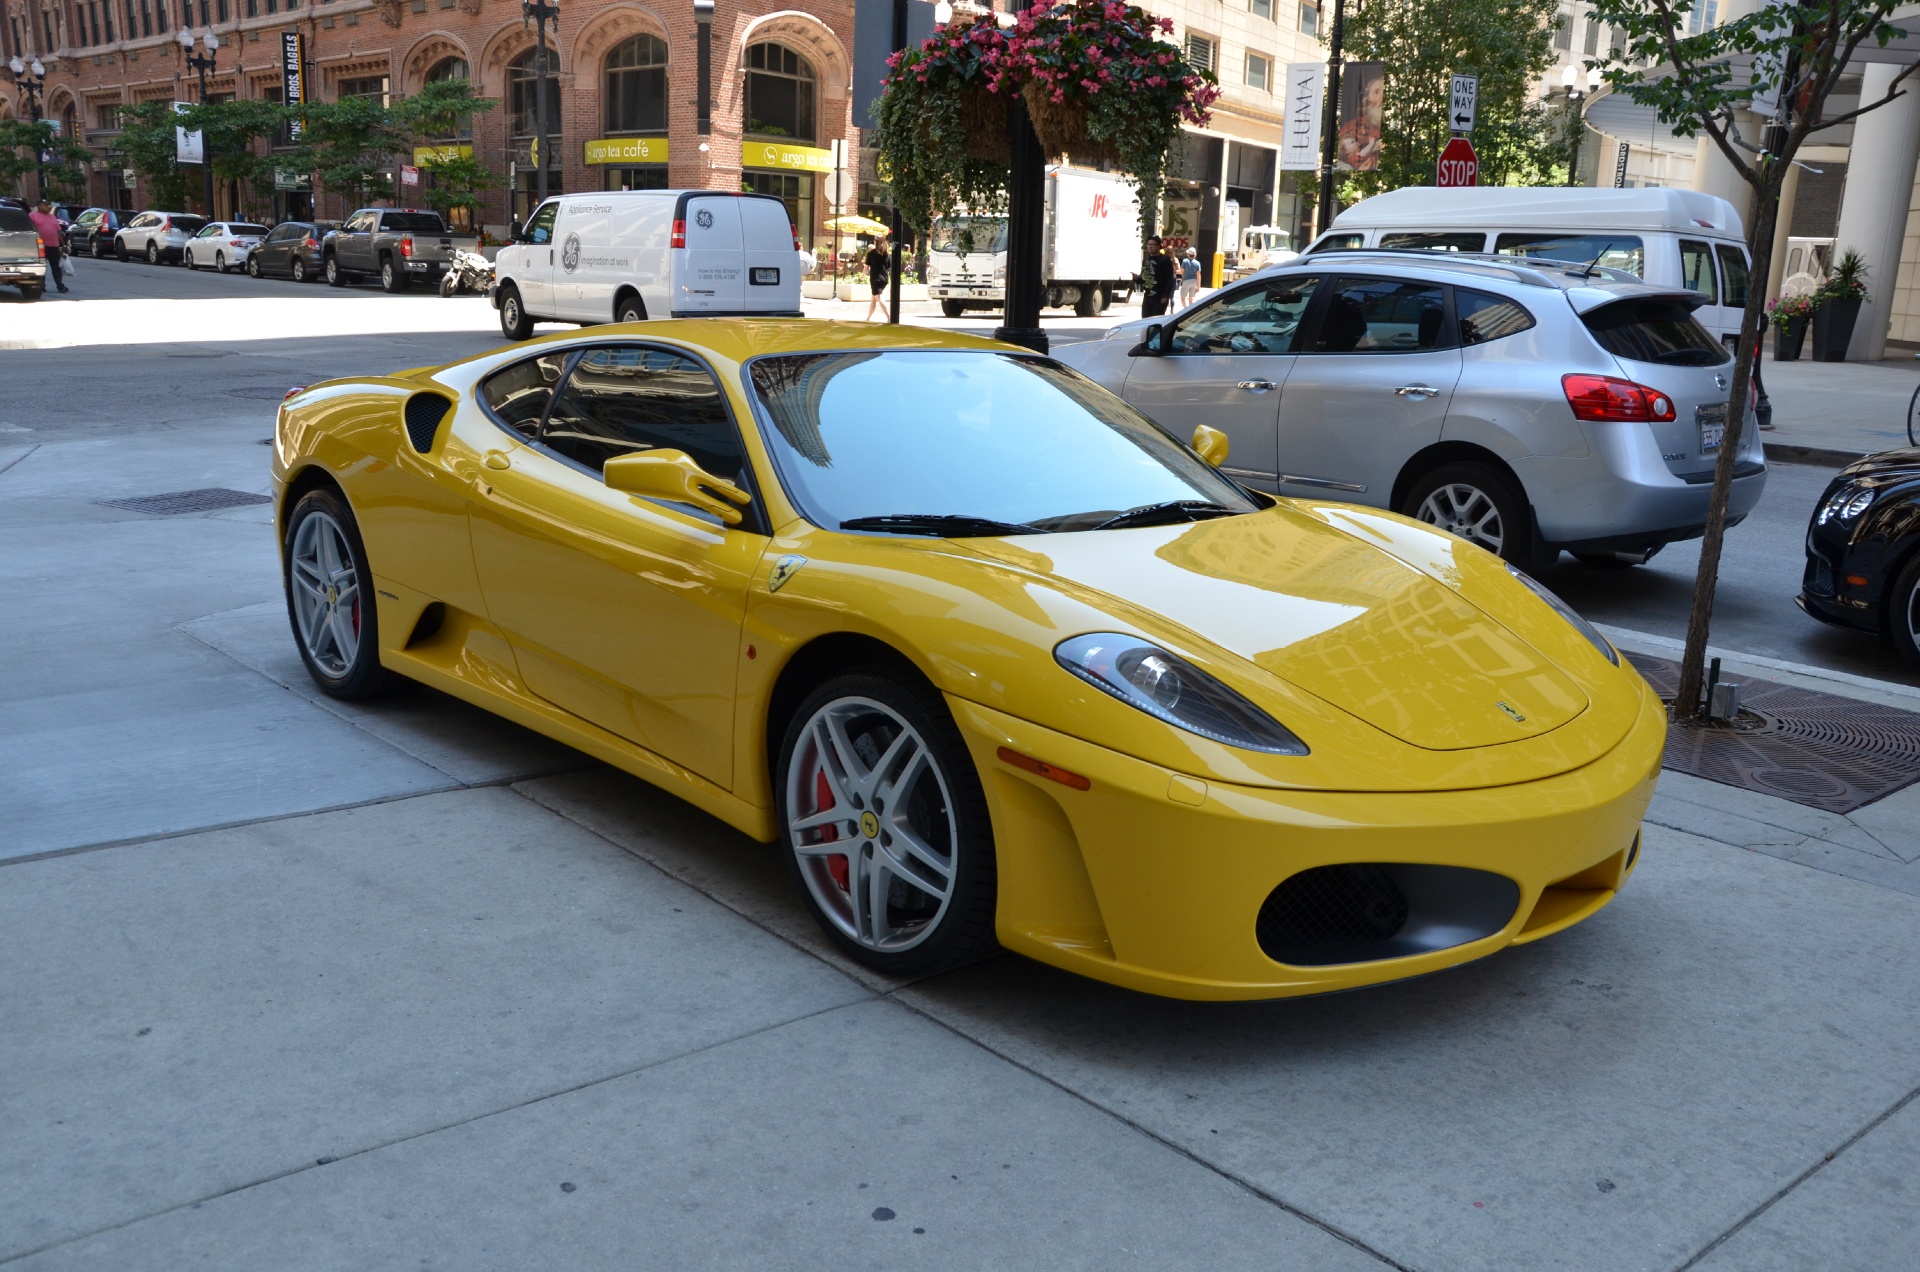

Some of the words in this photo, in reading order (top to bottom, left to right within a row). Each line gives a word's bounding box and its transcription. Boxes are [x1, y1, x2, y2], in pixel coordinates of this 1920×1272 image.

[286, 35, 298, 70] BAGELS
[288, 73, 301, 97] BROS.
[1454, 80, 1474, 95] ONE
[1454, 96, 1474, 110] WAY
[1293, 76, 1314, 149] LUMA
[608, 145, 620, 158] tea
[623, 139, 649, 157] café
[781, 152, 805, 167] argo
[806, 153, 819, 166] tea
[1440, 160, 1475, 186] STOP
[568, 204, 593, 216] Appliance
[593, 204, 612, 214] Service
[1088, 193, 1109, 219] JFC
[1162, 237, 1189, 249] OODS
[581, 256, 609, 267] imagination
[610, 258, 616, 266] at
[616, 257, 629, 266] work
